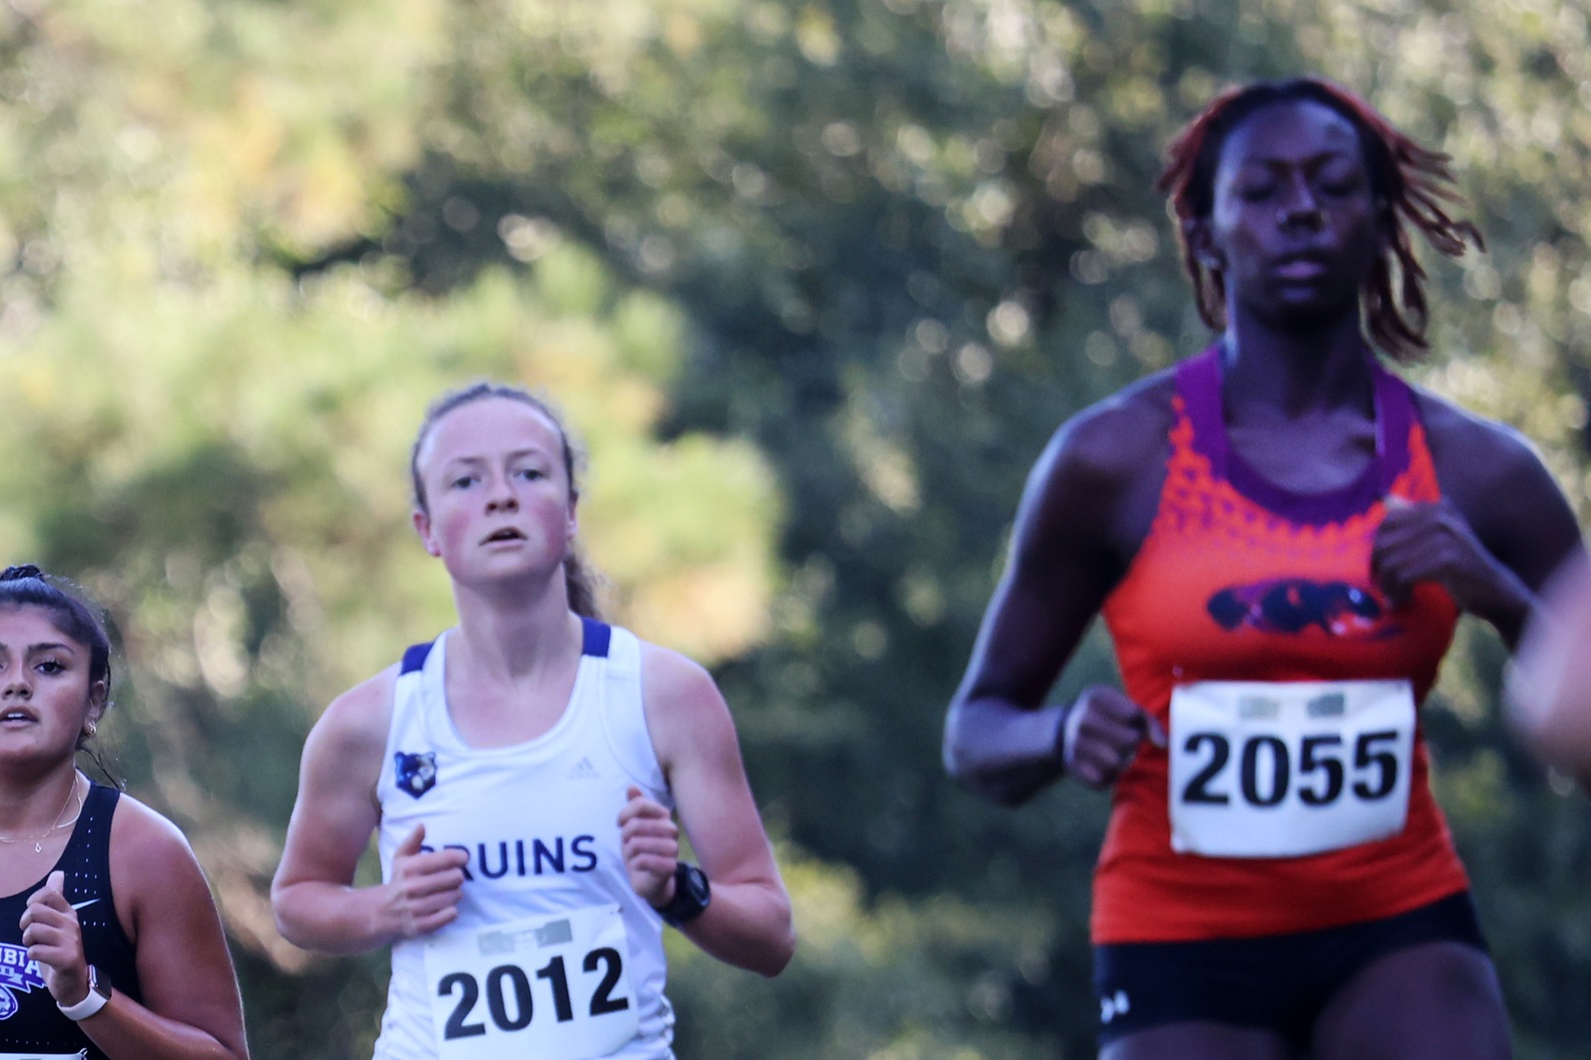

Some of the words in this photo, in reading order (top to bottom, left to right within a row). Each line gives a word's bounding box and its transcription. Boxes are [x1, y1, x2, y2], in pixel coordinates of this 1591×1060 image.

[1180, 729, 1399, 808] 2055
[420, 835, 598, 882] RUINS
[438, 946, 630, 1042] 2012
